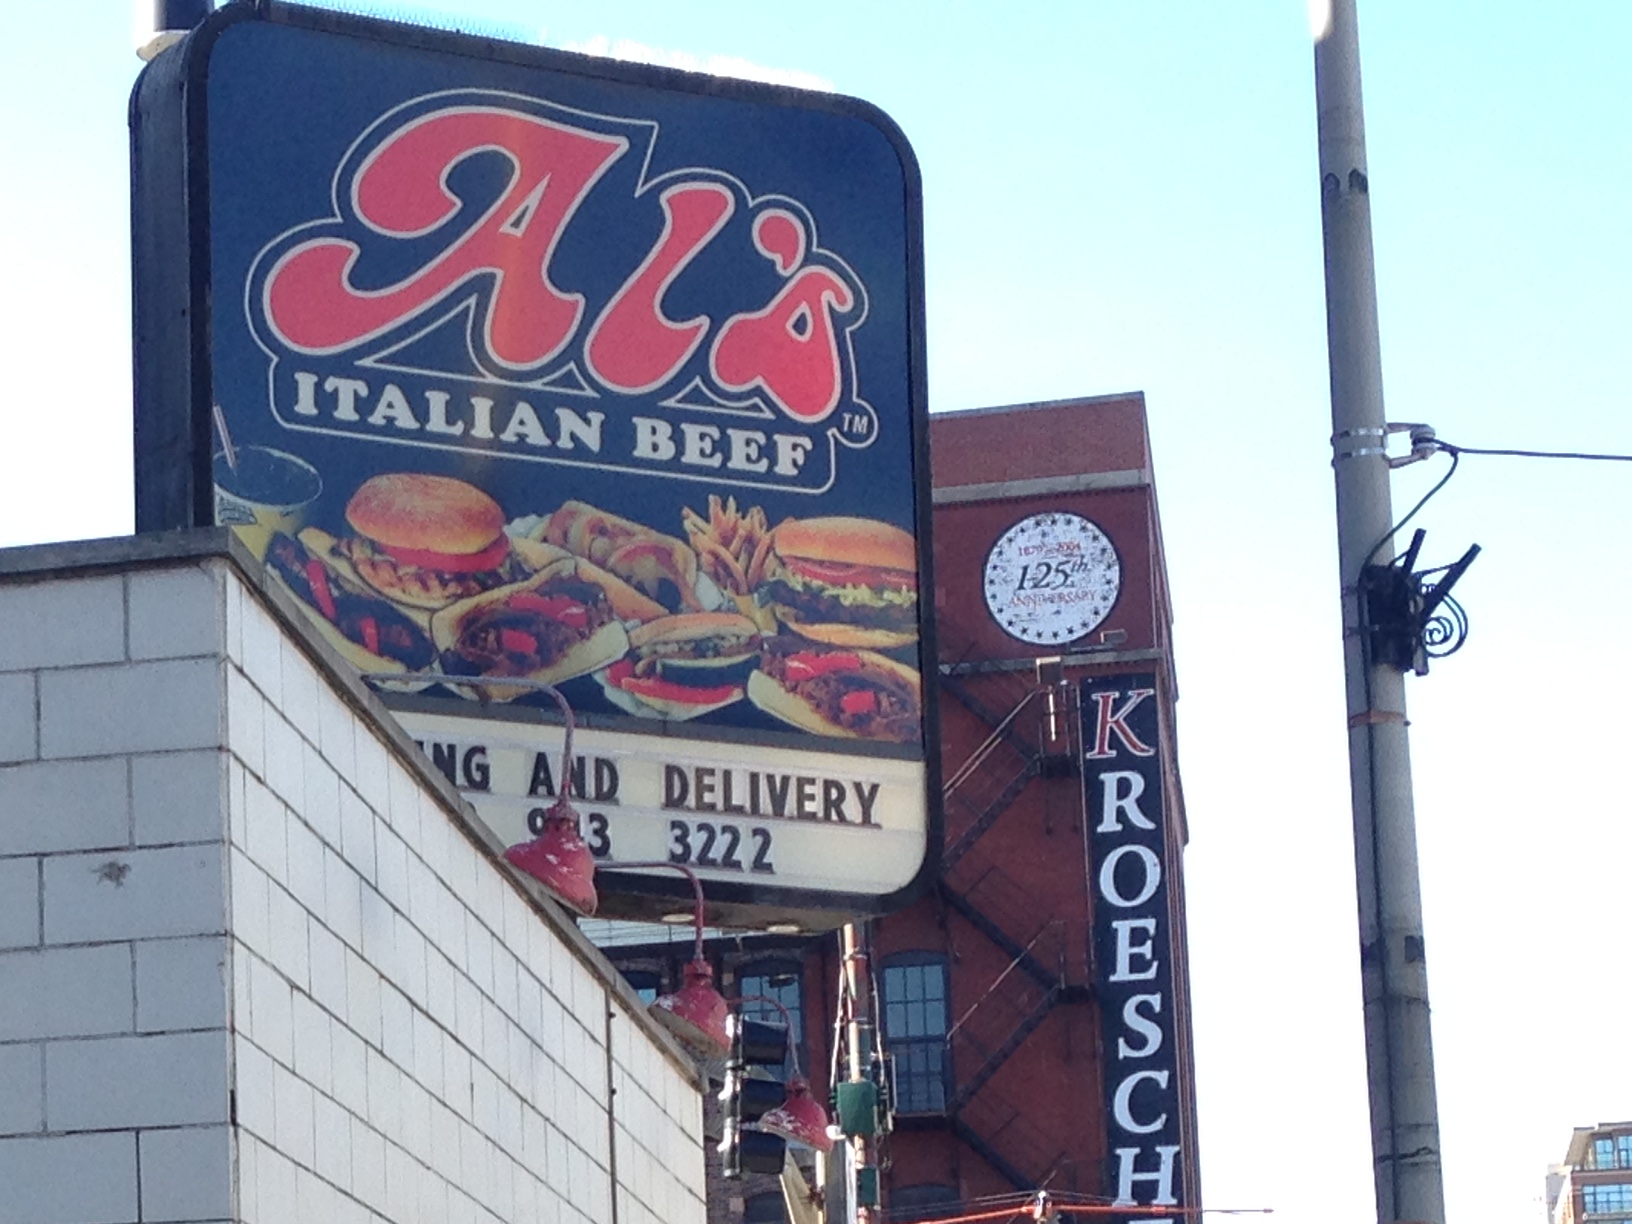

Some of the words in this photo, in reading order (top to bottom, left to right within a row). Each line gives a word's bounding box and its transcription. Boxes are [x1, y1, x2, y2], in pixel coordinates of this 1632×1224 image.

[262, 105, 855, 424] Al's
[293, 371, 604, 454] ITALIAN
[633, 418, 814, 478] BEEF
[529, 752, 620, 801] AND
[663, 763, 883, 828] DELIVERY
[527, 806, 613, 859] 93
[669, 820, 775, 874] 3222
